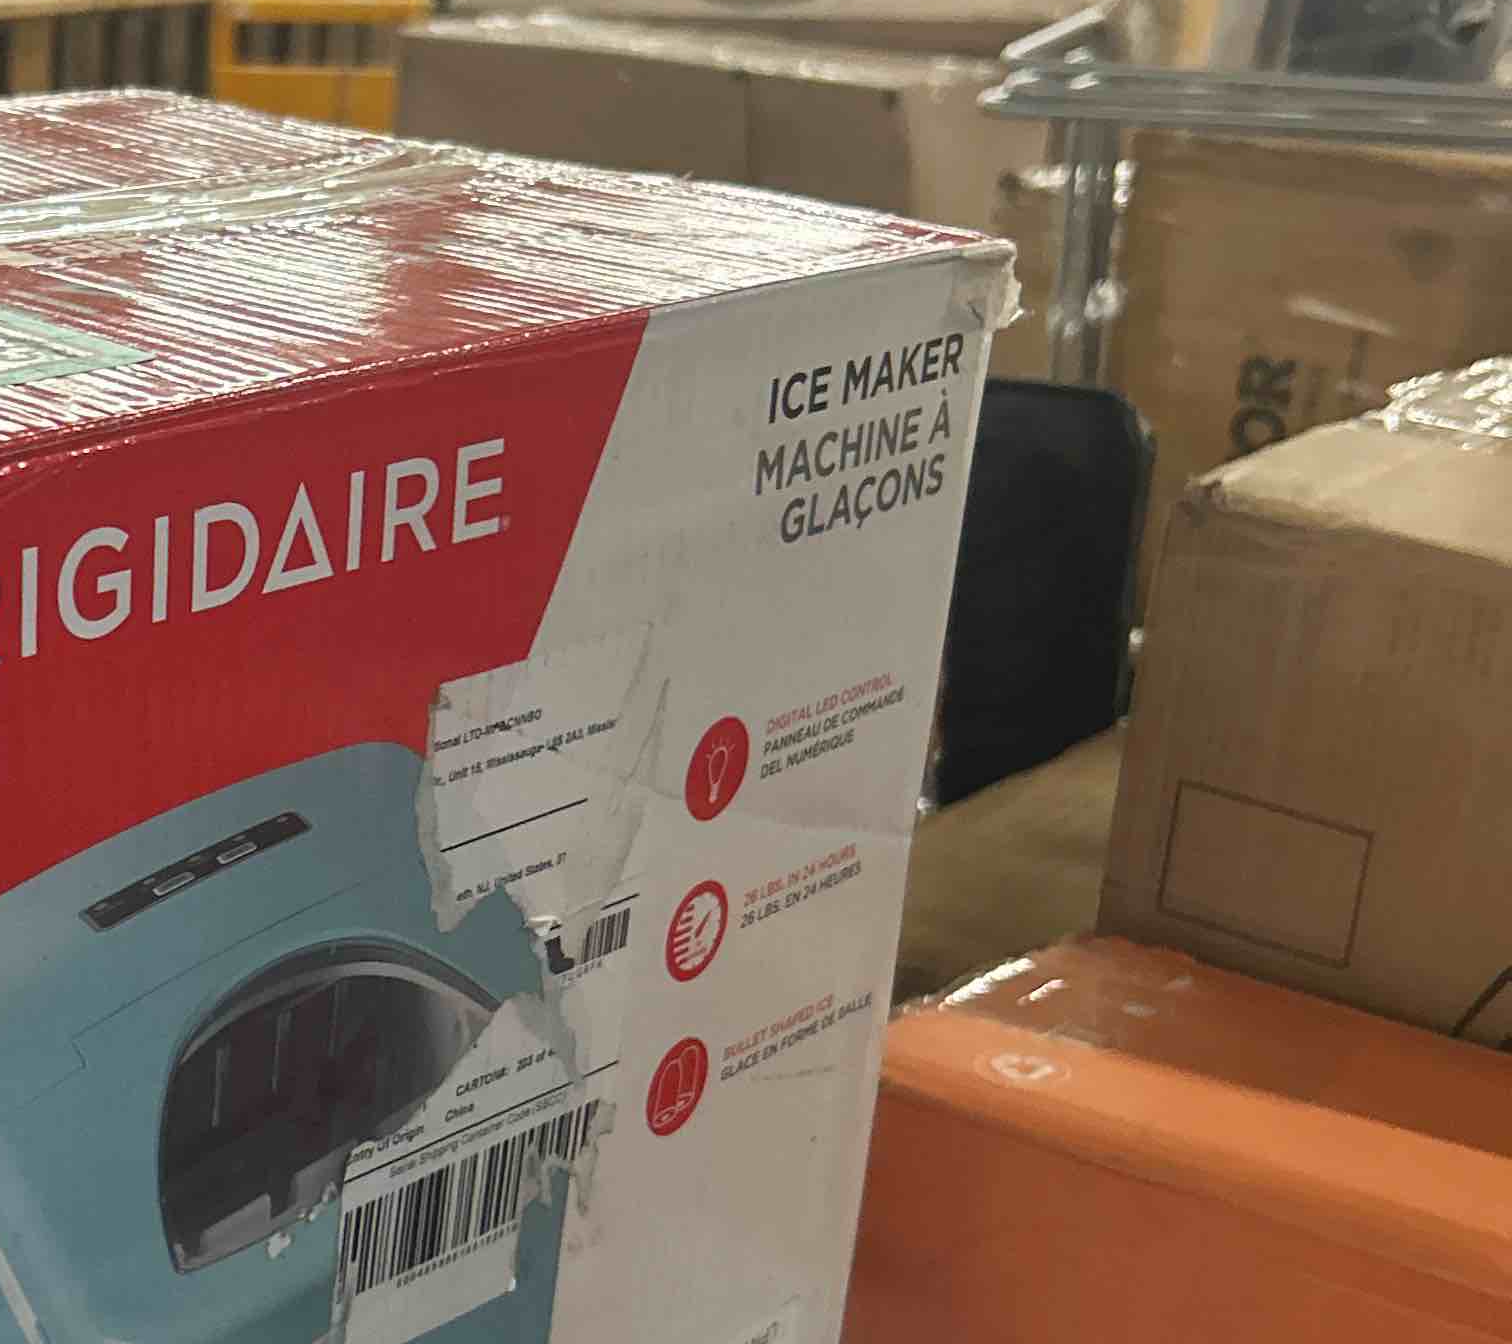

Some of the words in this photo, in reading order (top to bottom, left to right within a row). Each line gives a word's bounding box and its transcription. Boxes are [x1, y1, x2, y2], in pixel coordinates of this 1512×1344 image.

[768, 365, 833, 425] ICE
[841, 332, 965, 406] MAKER
[755, 407, 923, 496] MACHINE
[928, 387, 951, 445] À
[780, 453, 945, 544] GLAÇONS
[763, 719, 822, 756] PANNEAU
[823, 712, 840, 732] DE
[841, 686, 905, 726] COMMANDE
[766, 705, 813, 735] DIGITAL
[815, 694, 839, 716] LED
[840, 671, 896, 707] CONTROL
[759, 759, 783, 780] DEL
[785, 728, 855, 772] NUMÉRIQUE
